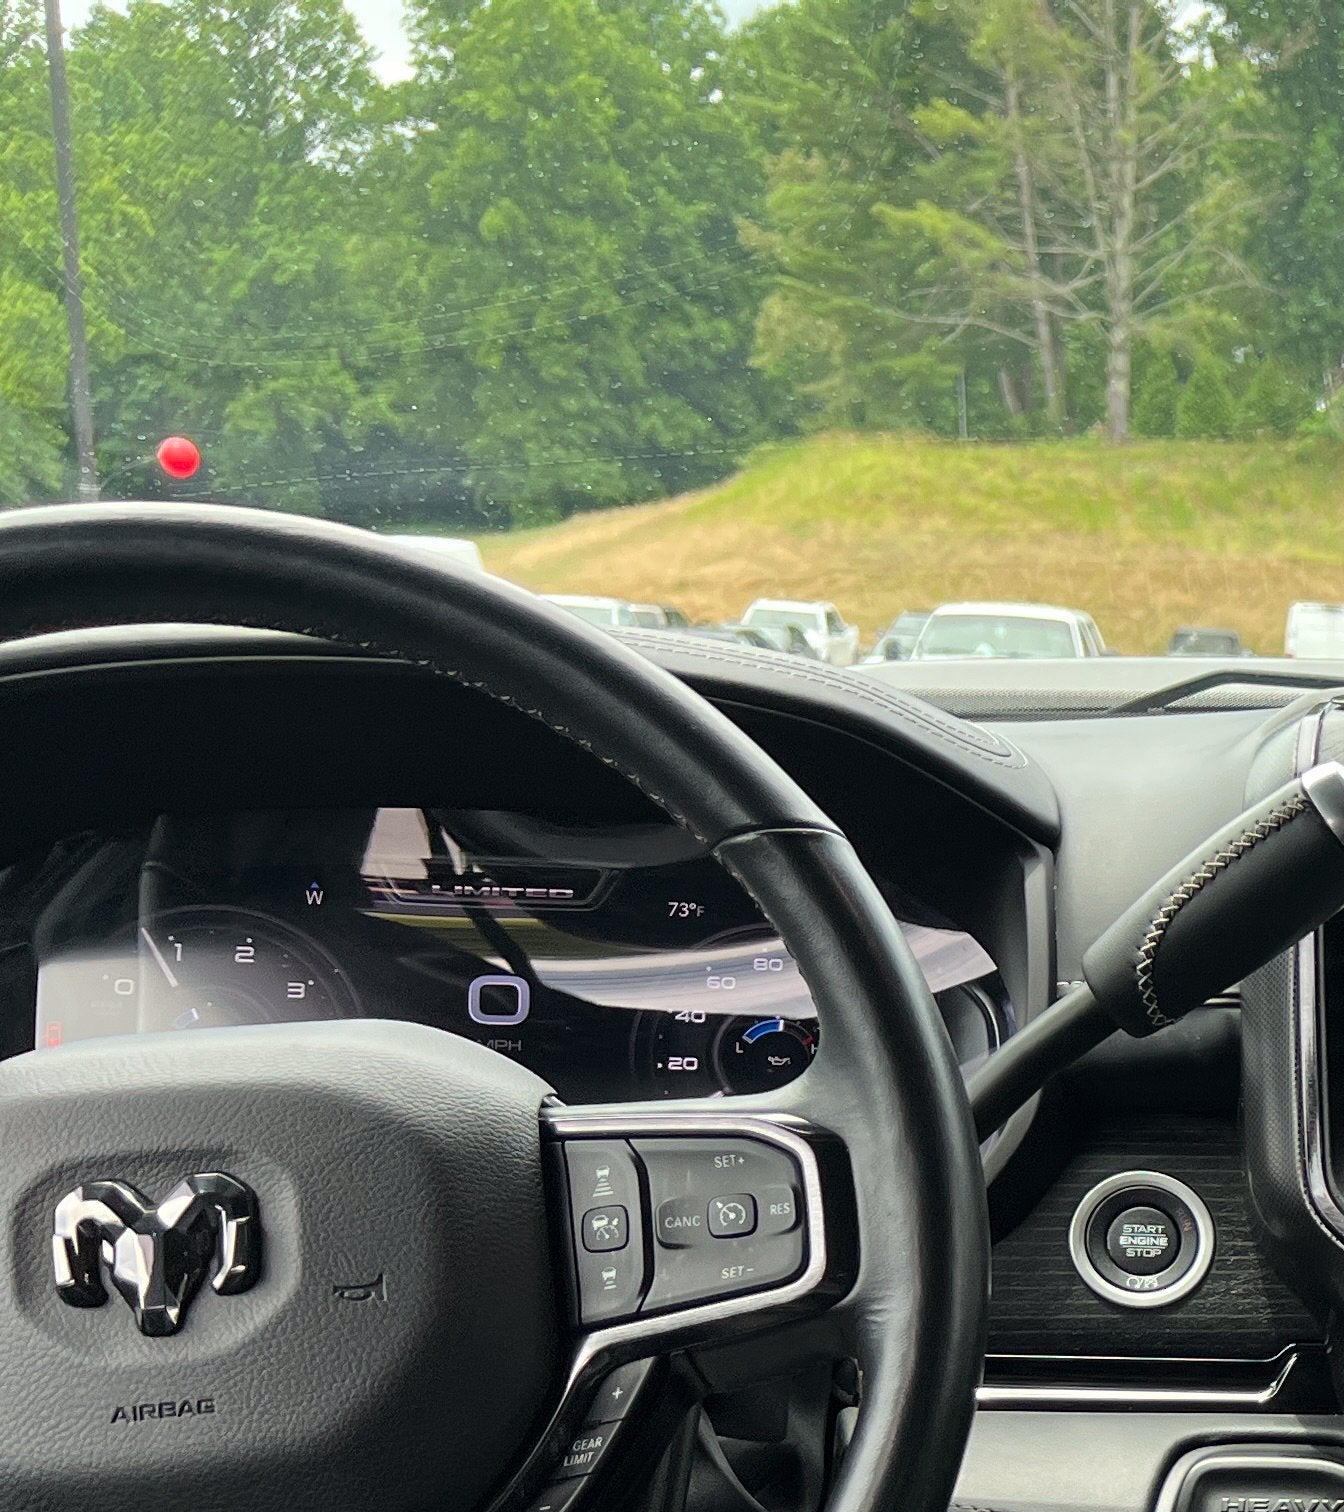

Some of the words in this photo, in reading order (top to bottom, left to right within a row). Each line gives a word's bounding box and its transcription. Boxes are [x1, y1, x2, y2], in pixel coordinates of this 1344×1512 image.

[305, 889, 324, 905] W
[431, 884, 574, 899] LIMITED
[174, 943, 184, 962] 1
[234, 945, 256, 963] 2
[753, 957, 784, 971] 80
[706, 976, 736, 990] 60
[287, 982, 306, 1000] 3
[675, 1010, 706, 1023] 40
[667, 1056, 698, 1071] 20
[769, 1202, 791, 1216] RES
[664, 1214, 701, 1229] CANC
[1122, 1224, 1166, 1234] START
[1119, 1235, 1169, 1247] ENGINE
[1125, 1247, 1162, 1258] STOP
[109, 1398, 216, 1424] AIRBAG
[572, 1436, 603, 1451] GEAR
[563, 1451, 595, 1467] LIMIT
